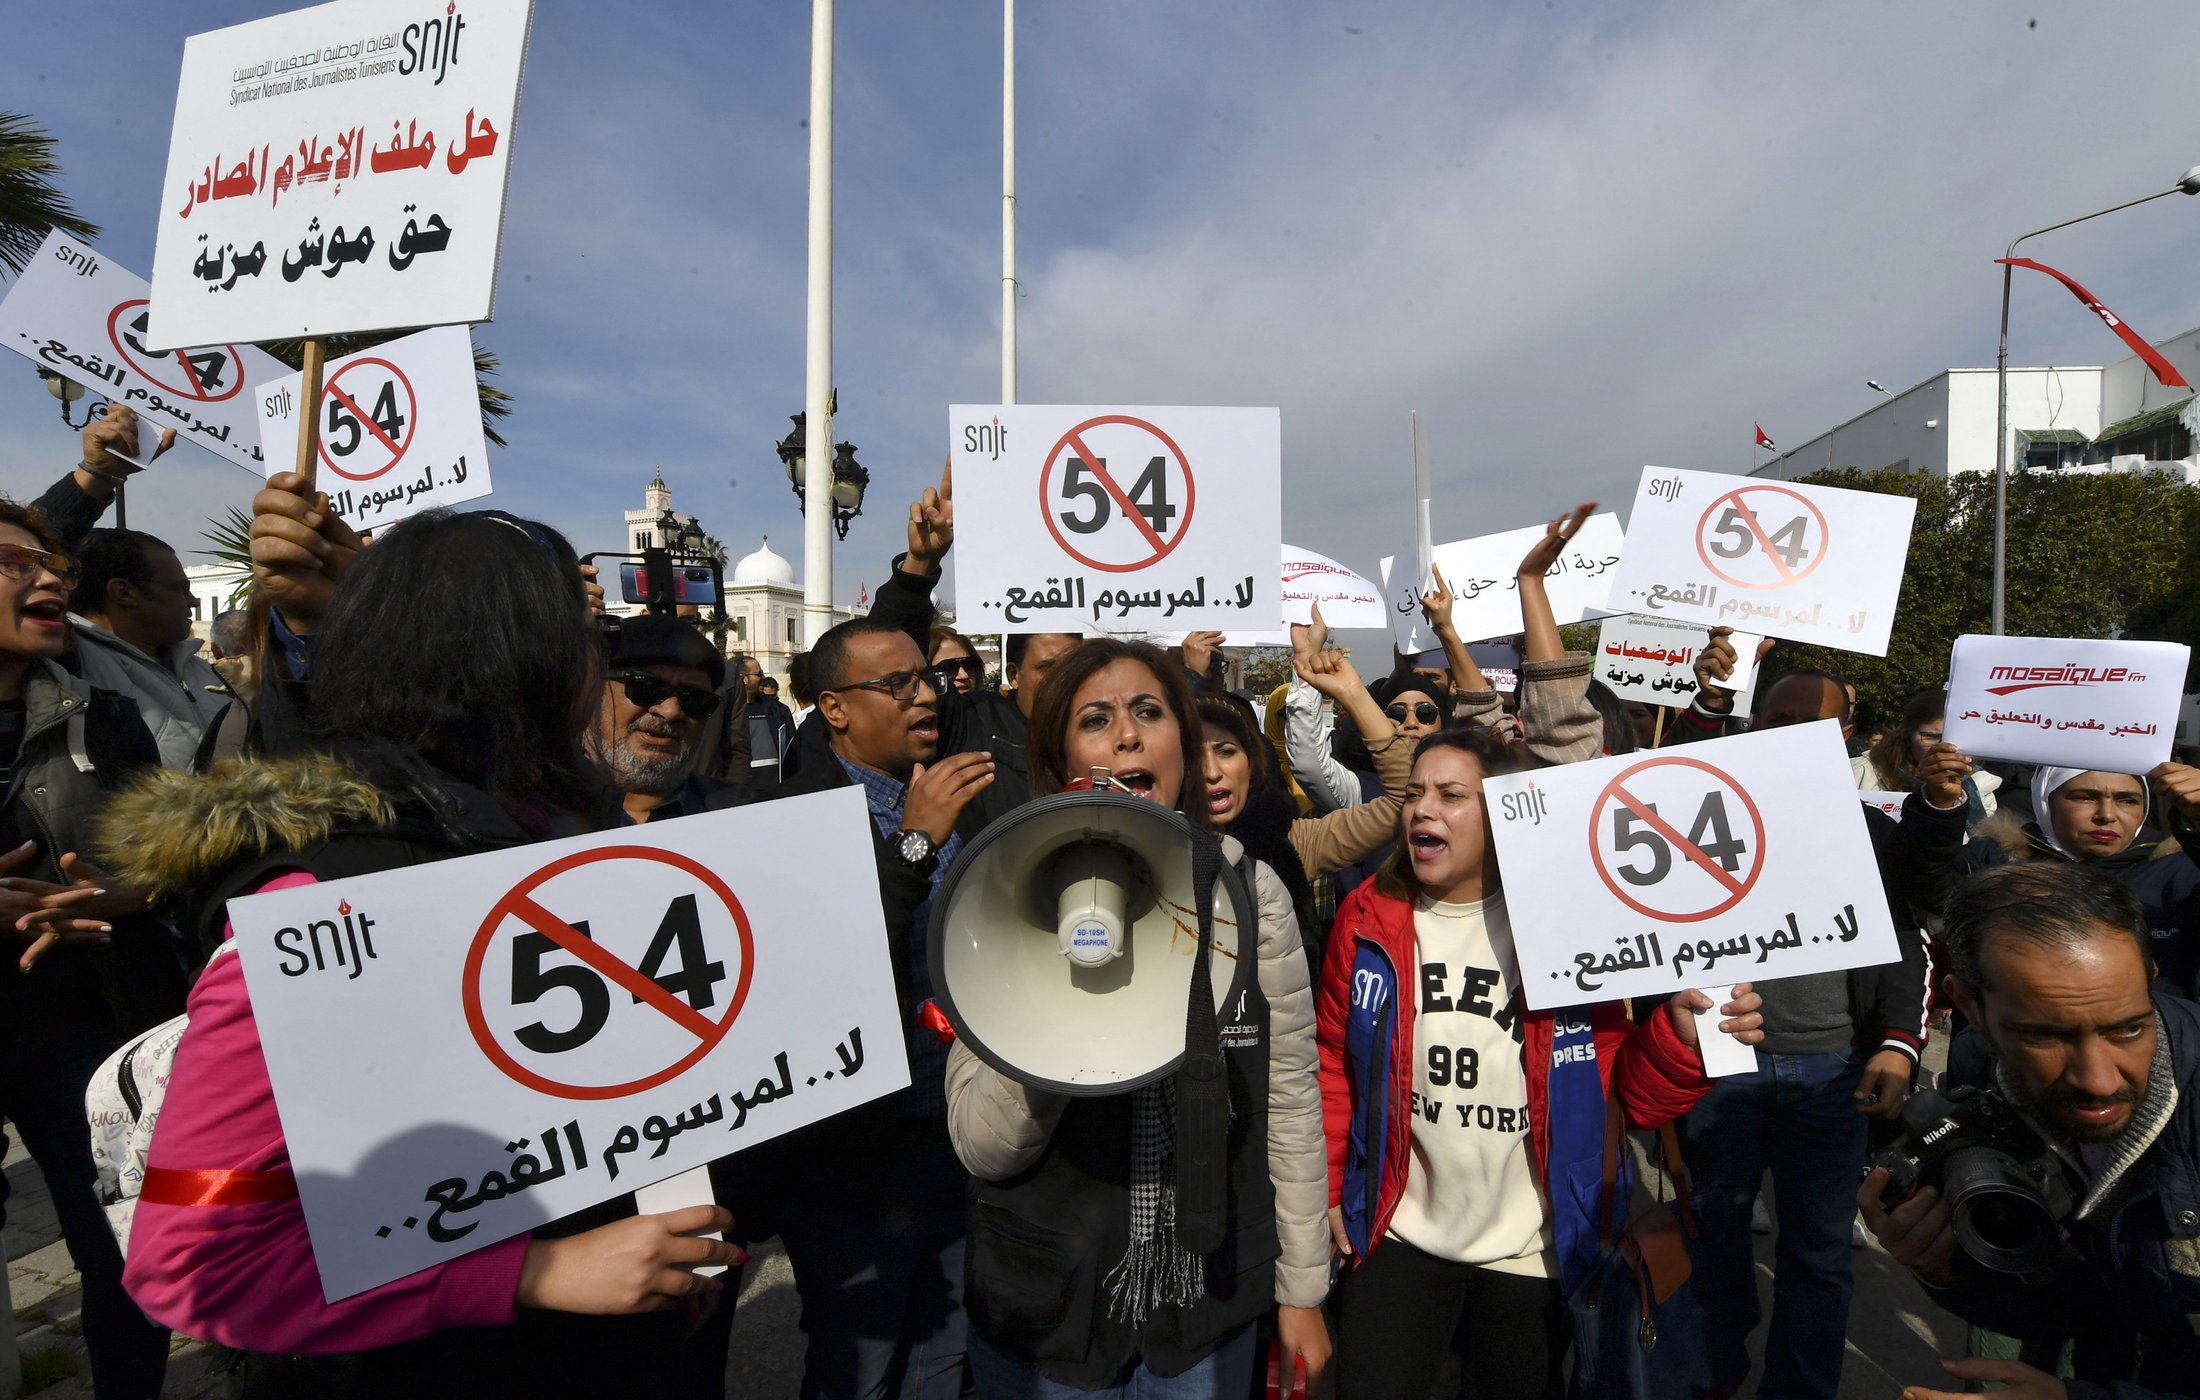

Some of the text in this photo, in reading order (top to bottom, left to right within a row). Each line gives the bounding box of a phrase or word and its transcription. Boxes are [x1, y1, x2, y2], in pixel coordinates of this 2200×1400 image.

[232, 32, 400, 84] النقابة الوطنية للصحفيين التونسيين
[399, 2, 466, 86] snjt
[229, 58, 396, 107] Syndicat National des Journalistes Tunisiens
[179, 107, 499, 219] حل ملف الإعلام المصادر
[55, 245, 101, 278] snjt
[192, 203, 452, 293] حق موش مزية
[125, 387, 232, 442] لمرسوم
[265, 386, 292, 419] snjt
[328, 380, 405, 457] 54
[964, 415, 1008, 461] snjt
[358, 465, 434, 521] لمرسوم
[1060, 456, 1176, 534] 54
[1648, 475, 1683, 503] snjt
[1710, 507, 1808, 568] 54
[1574, 552, 1620, 578] حرية
[1092, 576, 1206, 621] لمرسوم
[1322, 592, 1349, 602] مقدس
[1352, 595, 1376, 603] الخبر
[1462, 577, 1498, 600] حق
[1718, 598, 1822, 628] لمرسوم
[1605, 640, 1693, 667] الوضعيات
[1989, 663, 2147, 685] mosaïque fm
[1606, 663, 1698, 694] موش مزية
[1959, 709, 2157, 738] الخبر مقدس والتعليق حر
[1501, 779, 1548, 826] snjt
[1613, 790, 1747, 886] 54
[273, 898, 378, 980] snjt
[1077, 928, 1105, 936] SD-10SH
[1672, 912, 1801, 979] لمرسوم
[510, 893, 727, 1054] 54
[1428, 1044, 1479, 1089] 98
[602, 1051, 795, 1181] لمرسوم
[1922, 1121, 1953, 1145] Nikon
